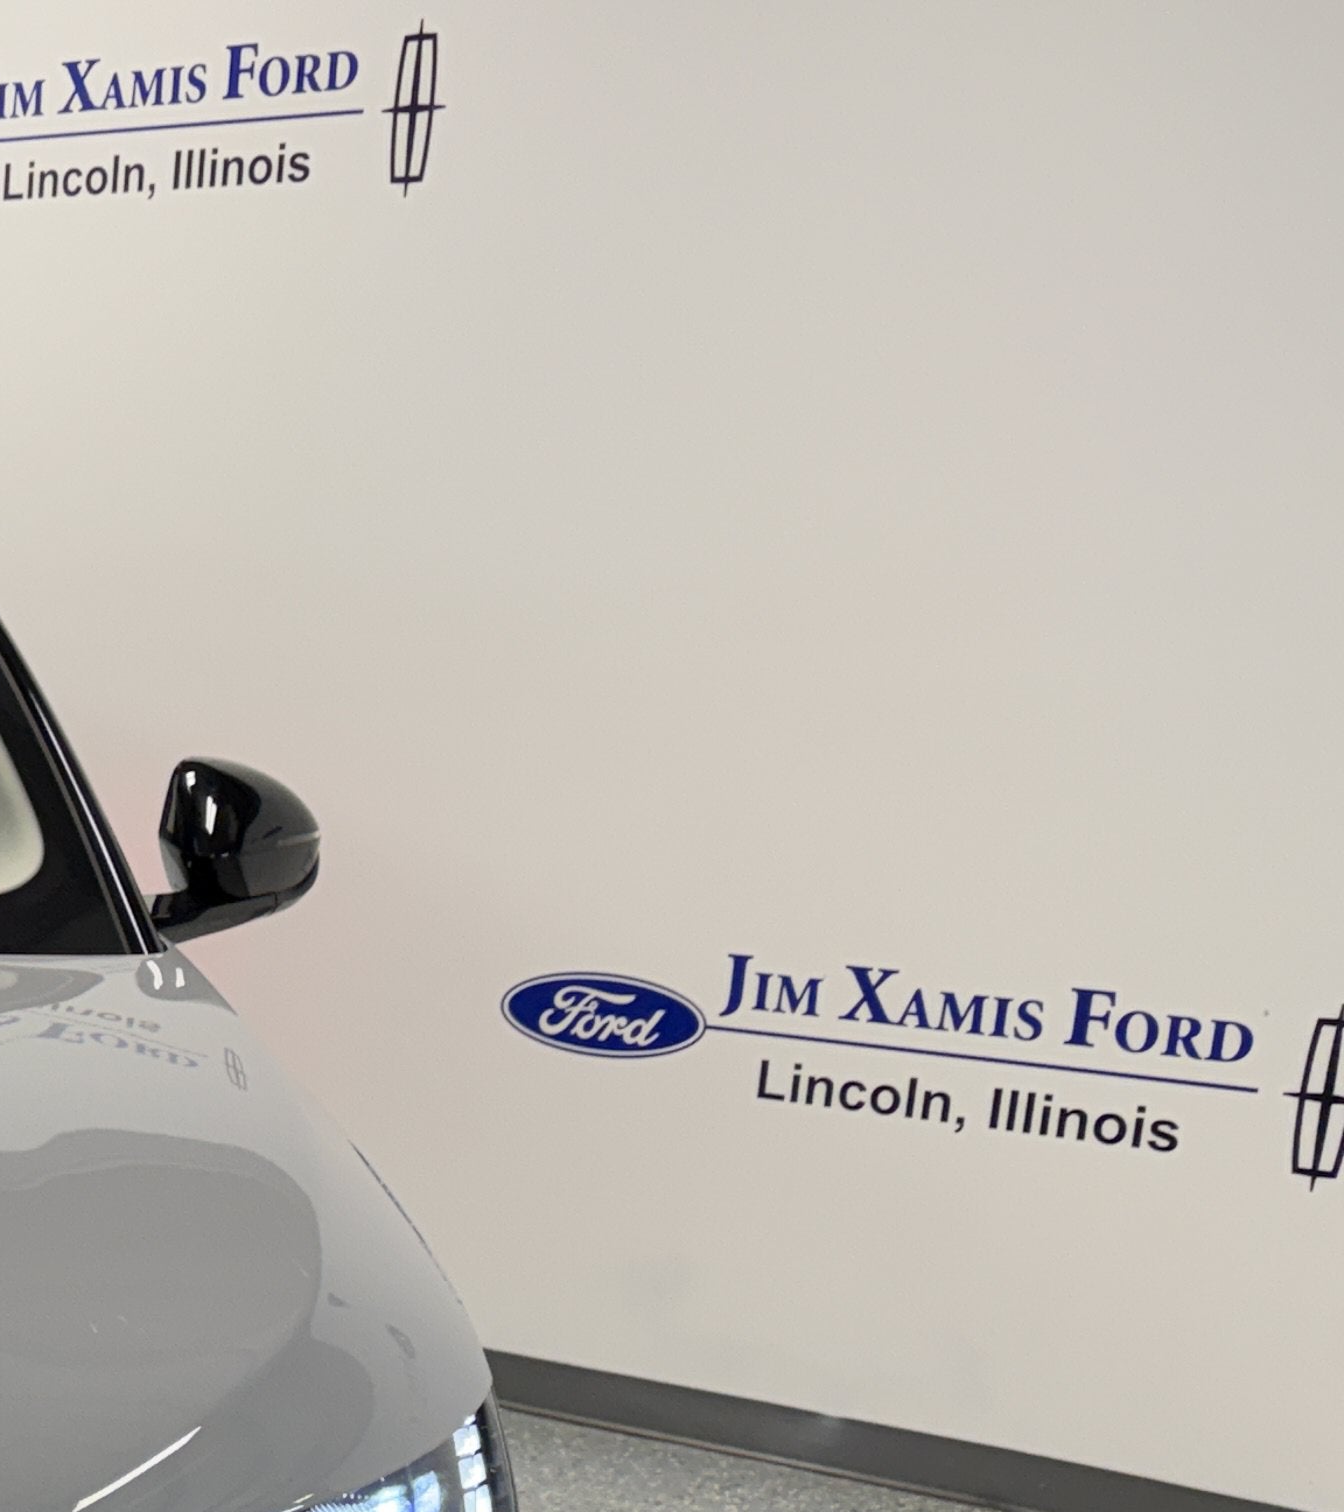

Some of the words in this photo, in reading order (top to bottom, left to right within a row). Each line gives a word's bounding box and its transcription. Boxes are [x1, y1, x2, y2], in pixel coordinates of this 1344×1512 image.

[58, 59, 207, 114] XAMIS
[223, 43, 359, 100] FORD
[3, 155, 155, 200] Lincoln,
[172, 143, 310, 190] Illinois
[538, 986, 659, 1048] Ford
[719, 954, 823, 1017] JIM
[839, 965, 1044, 1041] XAMIS
[1063, 987, 1254, 1063] FORD
[757, 1059, 965, 1133] Lincoln,
[988, 1087, 1179, 1153] Illinois
